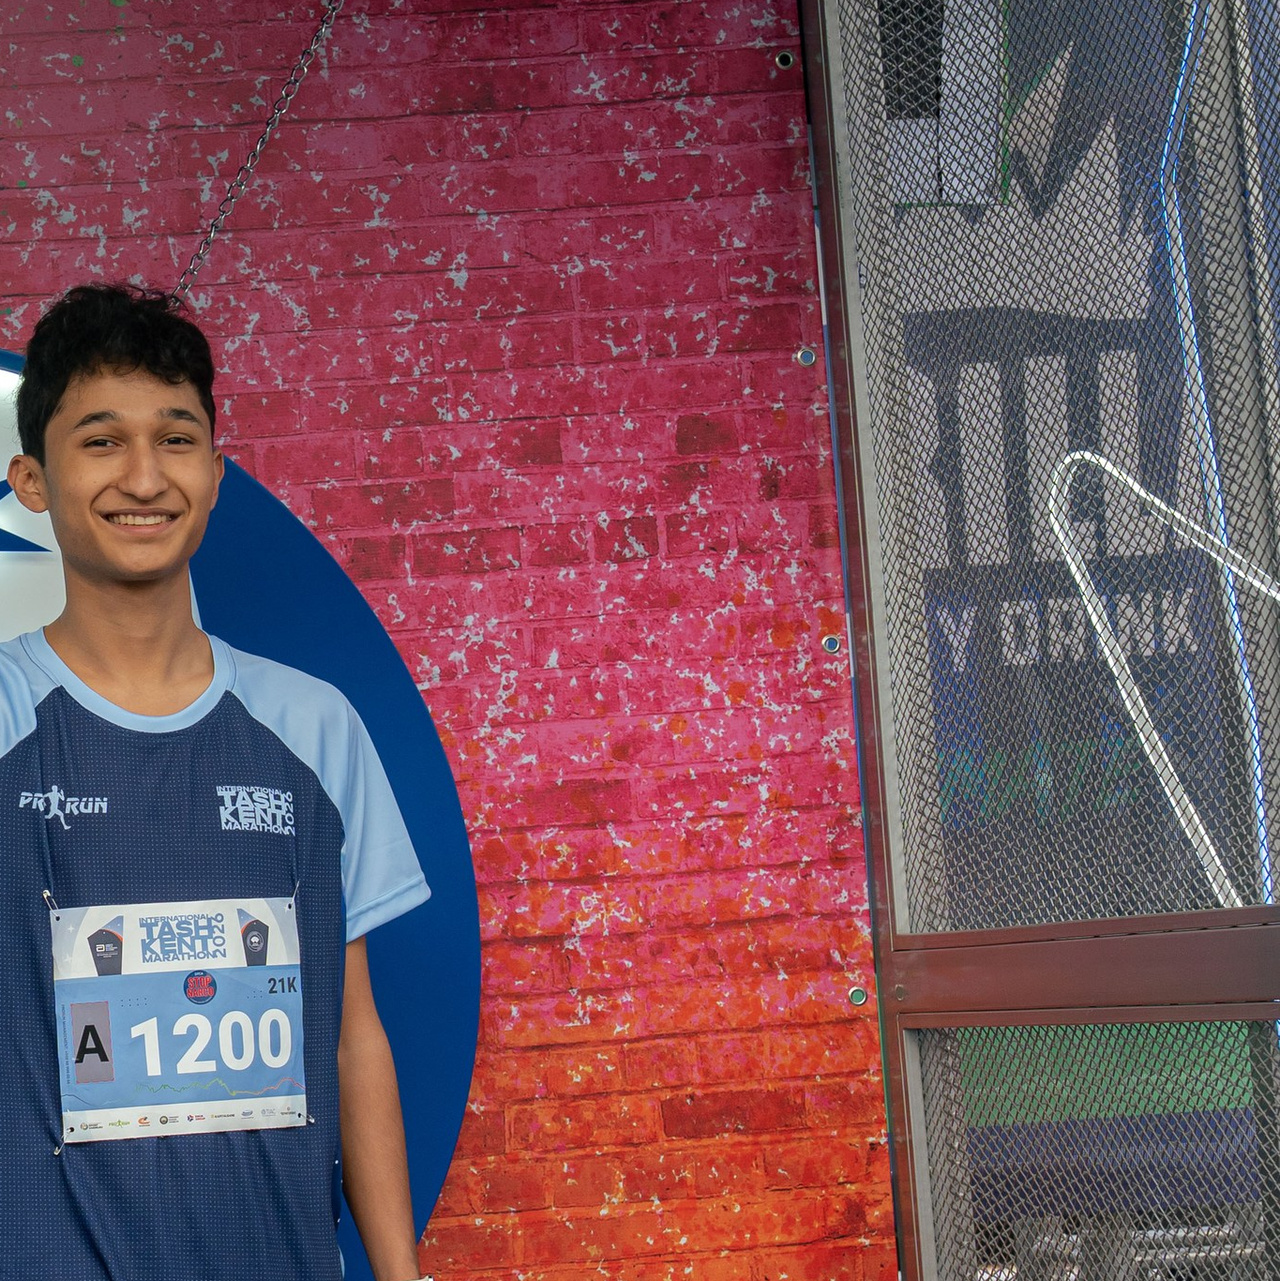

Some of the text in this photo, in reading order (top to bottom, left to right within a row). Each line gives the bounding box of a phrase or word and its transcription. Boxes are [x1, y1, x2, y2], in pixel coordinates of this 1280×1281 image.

[998, 586, 1198, 670] DRNK
[216, 785, 282, 795] INTERNATIONAL
[65, 797, 108, 816] RUN
[216, 790, 286, 815] TASH
[219, 806, 285, 826] KENT
[284, 791, 296, 837] 2026
[221, 821, 290, 836] MARATHON
[139, 913, 209, 924] INTERNATIONAL
[139, 917, 214, 941] TASH
[211, 913, 227, 958] 2026
[140, 936, 210, 956] KENT
[142, 950, 217, 963] MARATHON
[186, 986, 215, 998] NARCO
[187, 975, 212, 989] STOP
[268, 976, 298, 995] 21K
[75, 1024, 110, 1064] A
[130, 1008, 293, 1077] 1200
